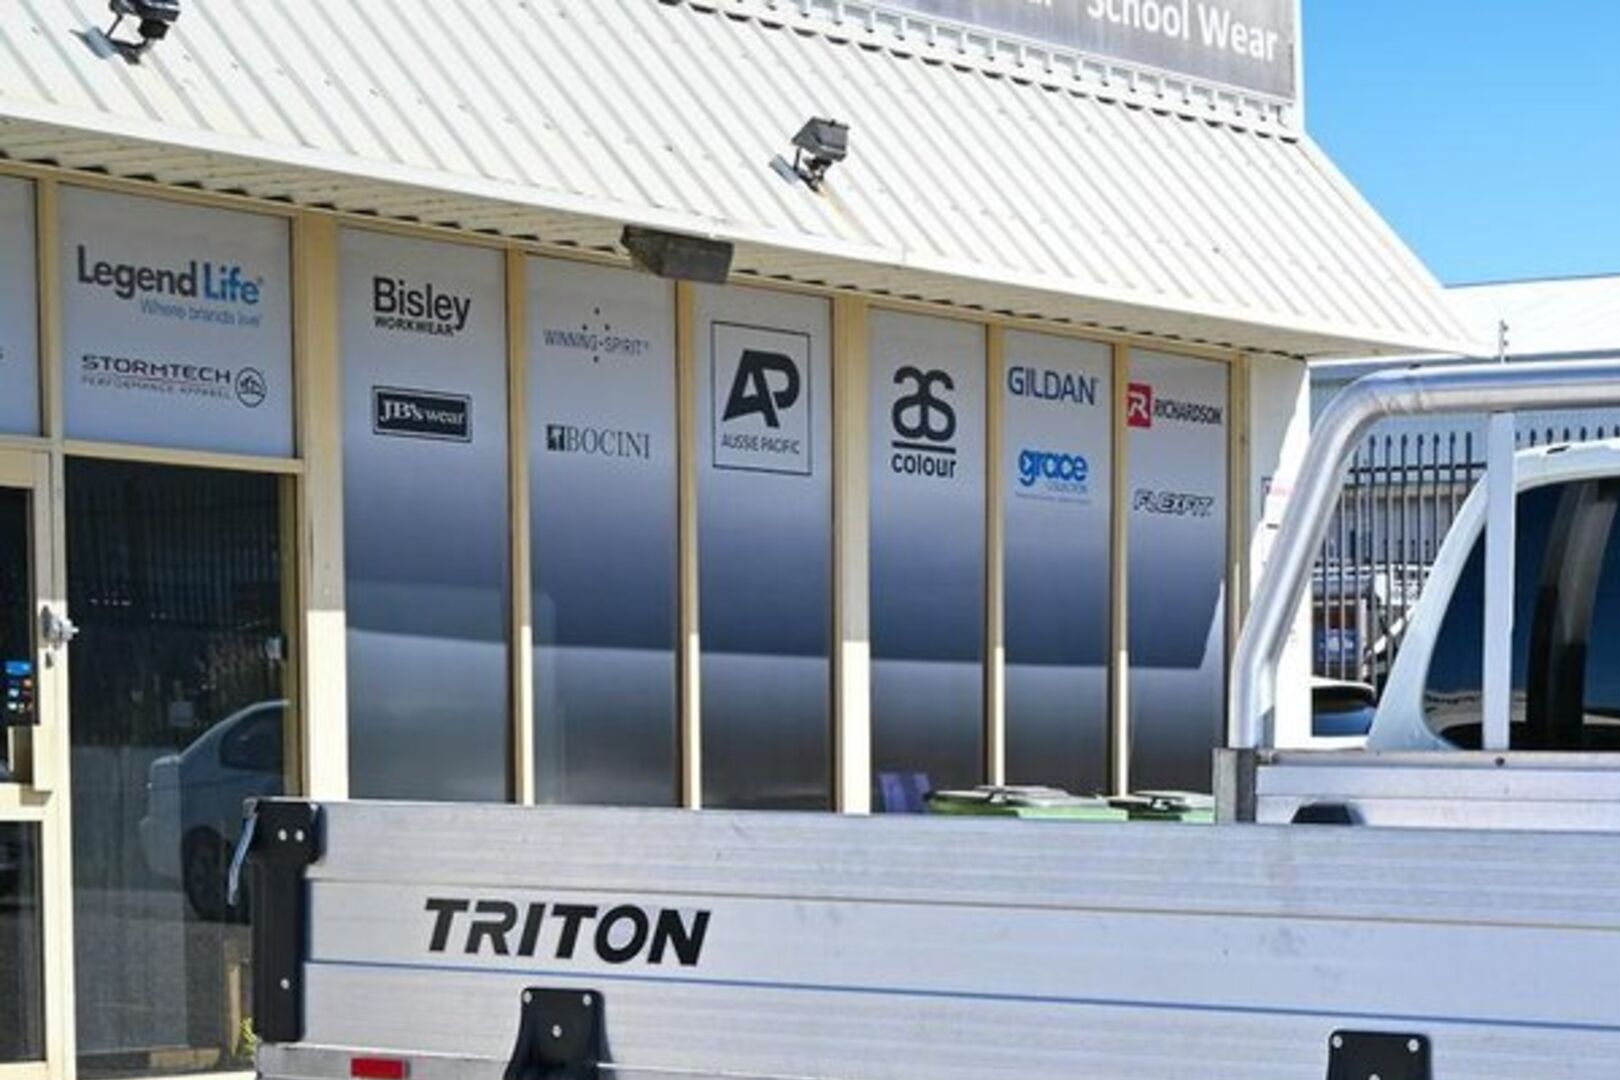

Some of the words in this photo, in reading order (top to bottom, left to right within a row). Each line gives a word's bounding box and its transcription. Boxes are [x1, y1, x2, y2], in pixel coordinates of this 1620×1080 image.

[1199, 6, 1278, 62] Wear
[77, 244, 197, 300] Legend
[203, 262, 261, 305] Life
[373, 276, 471, 330] Bisley
[375, 316, 455, 336] WORKWEAR
[82, 354, 231, 384] STORMTECH
[1007, 365, 1095, 406] GILDAN
[425, 409, 464, 425] wear
[1154, 398, 1222, 425] RICHARDSON
[565, 425, 650, 460] BOCINI
[890, 453, 957, 479] colour
[1018, 449, 1088, 487] grace
[424, 897, 712, 967] TRITON
